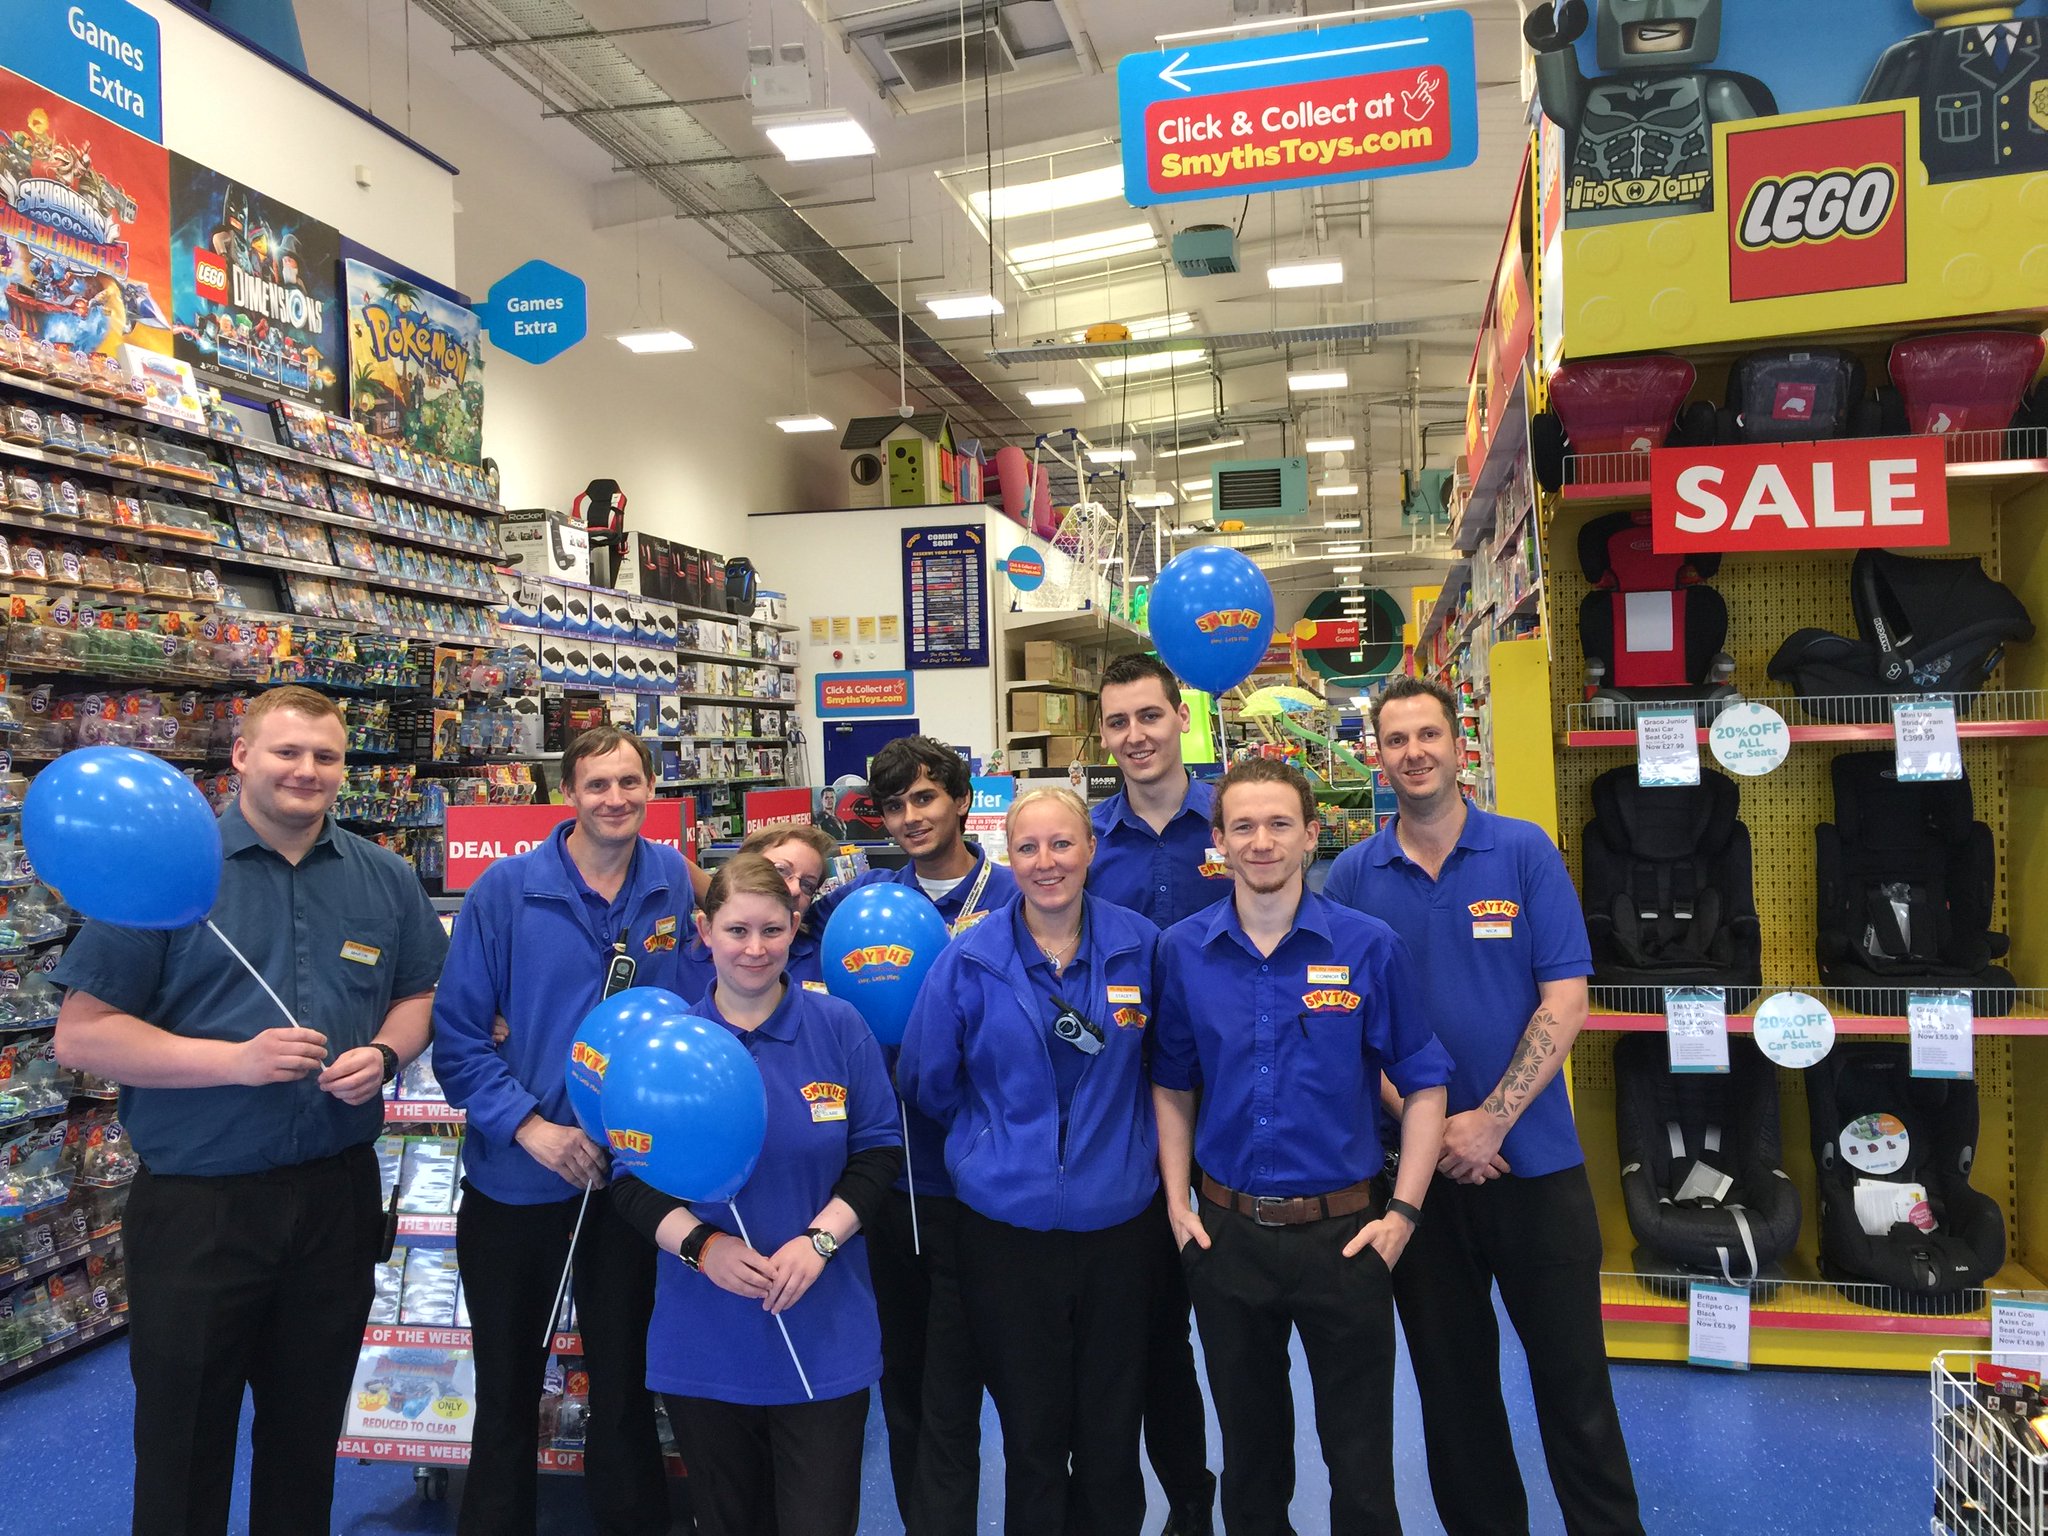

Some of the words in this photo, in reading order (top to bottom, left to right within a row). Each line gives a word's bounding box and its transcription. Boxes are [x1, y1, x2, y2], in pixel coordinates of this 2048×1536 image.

[68, 6, 144, 72] Games
[88, 61, 144, 118] Extra
[1157, 113, 1223, 145] Click
[1230, 110, 1253, 136] &
[1261, 97, 1358, 133] Collect
[1364, 92, 1395, 119] at
[1161, 125, 1433, 179] SmythsToys.com
[18, 180, 106, 245] SKYLANDERS
[1742, 170, 1896, 245] LEGO
[198, 264, 225, 289] LEGO
[232, 264, 323, 334] DIMENSIONS
[507, 296, 564, 312] Games
[514, 321, 558, 336] Extra
[1674, 458, 1925, 533] SALE
[508, 511, 544, 521] Rocker
[927, 533, 958, 541] COMING
[1196, 610, 1260, 632] SMYTHS
[1337, 627, 1355, 635] Board
[1335, 635, 1355, 643] Games
[825, 686, 844, 695] Click
[854, 685, 882, 693] Collect
[826, 695, 903, 705] SmythsToys.com
[1738, 738, 1764, 749] ALL
[1903, 734, 1935, 742] £399.99
[1724, 750, 1744, 759] Car
[1746, 747, 1778, 758] Seats
[968, 789, 1002, 808] ffer
[747, 817, 763, 834] DEAL
[790, 813, 811, 825] WEEK!
[450, 842, 508, 859] DEAL
[1470, 900, 1519, 917] SMYTHS
[843, 947, 912, 971] SMYTHS
[1304, 991, 1359, 1008] SMYTHS
[1782, 1029, 1809, 1040] ALL
[1767, 1041, 1788, 1051] Car
[1790, 1040, 1823, 1049] Seats
[802, 1083, 847, 1101] SMYTHS
[394, 1105, 423, 1116] THE
[429, 1217, 457, 1231] WEE
[1697, 1293, 1718, 1301] Britax
[1697, 1302, 1723, 1310] Eclipse
[372, 1330, 392, 1342] OF
[396, 1330, 425, 1343] THE
[2017, 1328, 2040, 1336] Group
[555, 1338, 576, 1349] OF
[438, 1401, 462, 1411] ONLY
[362, 1417, 409, 1431] REDUCED
[411, 1421, 424, 1432] TO
[426, 1423, 456, 1434] CLEAR
[373, 1443, 392, 1455] OF
[397, 1444, 426, 1457] THE
[557, 1453, 577, 1465] OF
